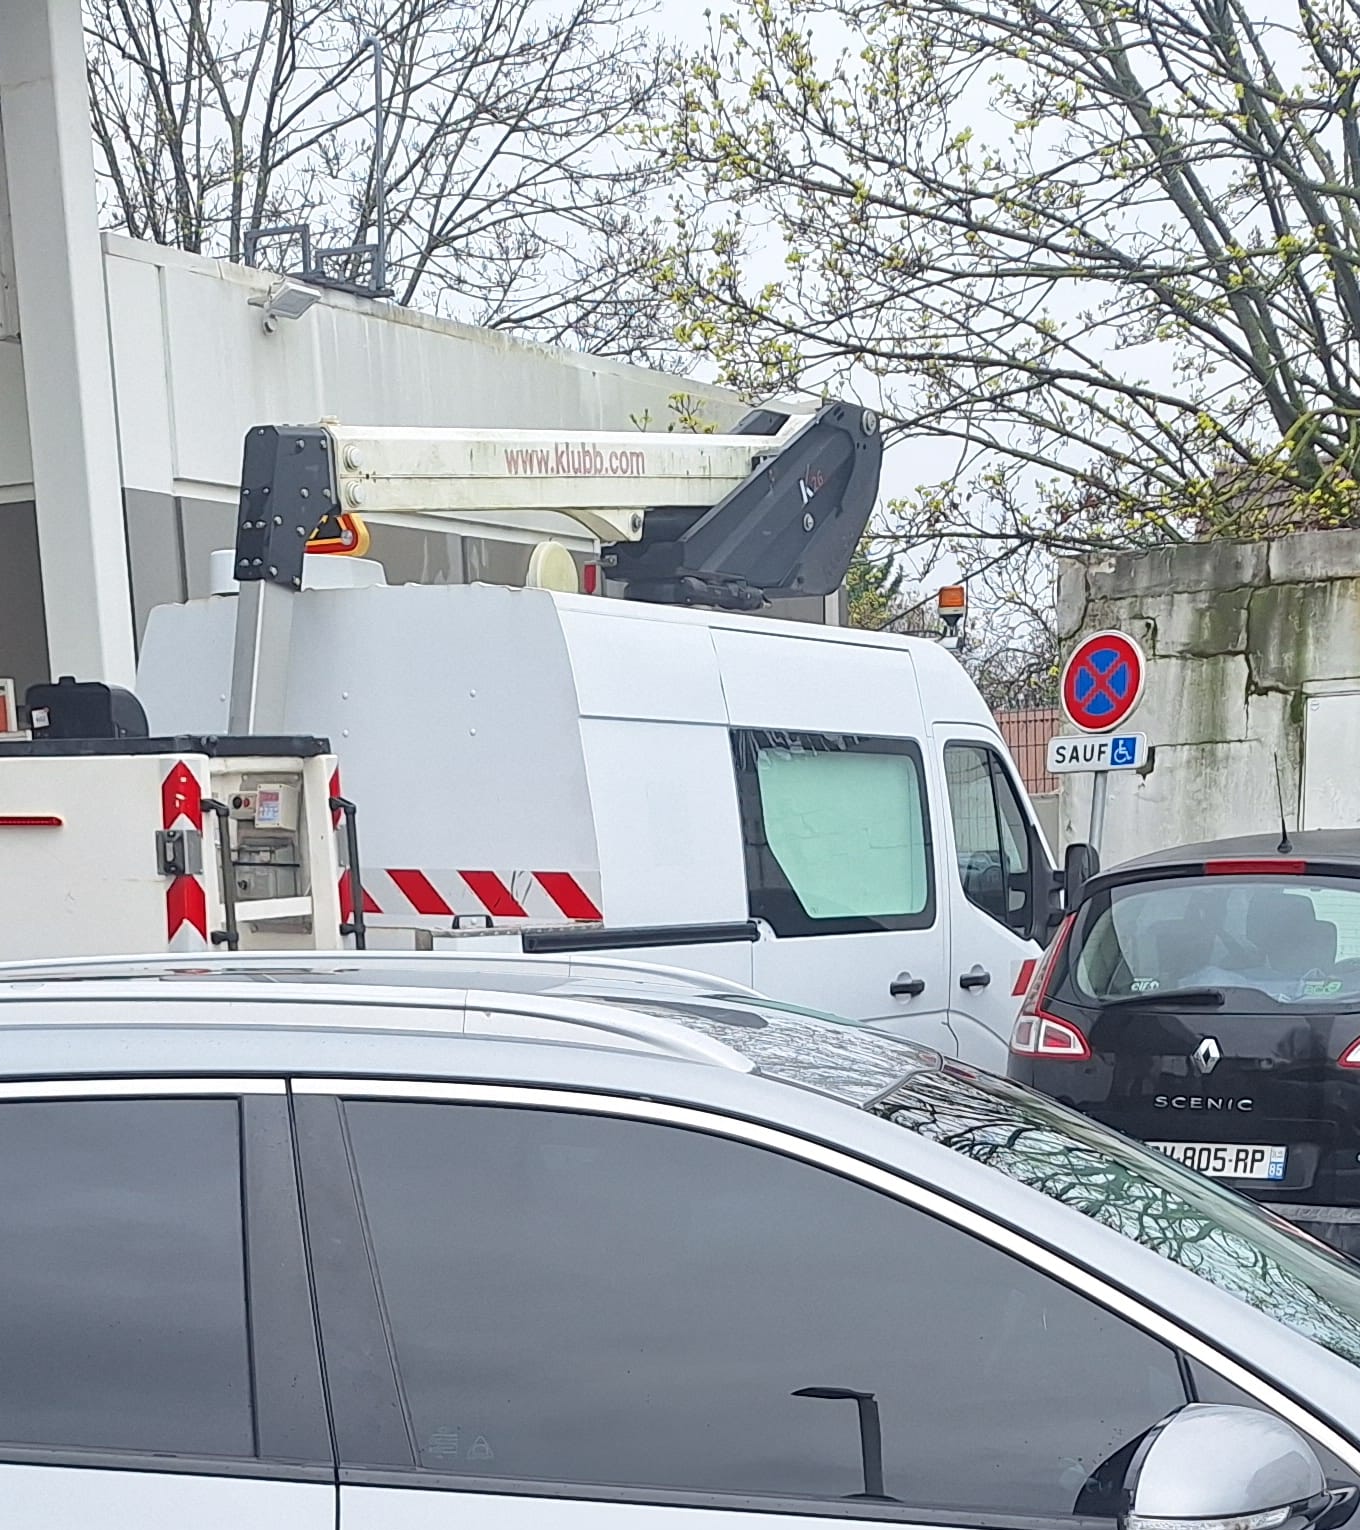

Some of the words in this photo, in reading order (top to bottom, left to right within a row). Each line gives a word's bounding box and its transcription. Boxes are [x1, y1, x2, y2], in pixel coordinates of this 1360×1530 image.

[504, 442, 646, 475] www.klubb.com
[1054, 743, 1109, 764] SAUF
[1154, 1096, 1253, 1111] SCENIC
[1269, 1163, 1283, 1177] 85
